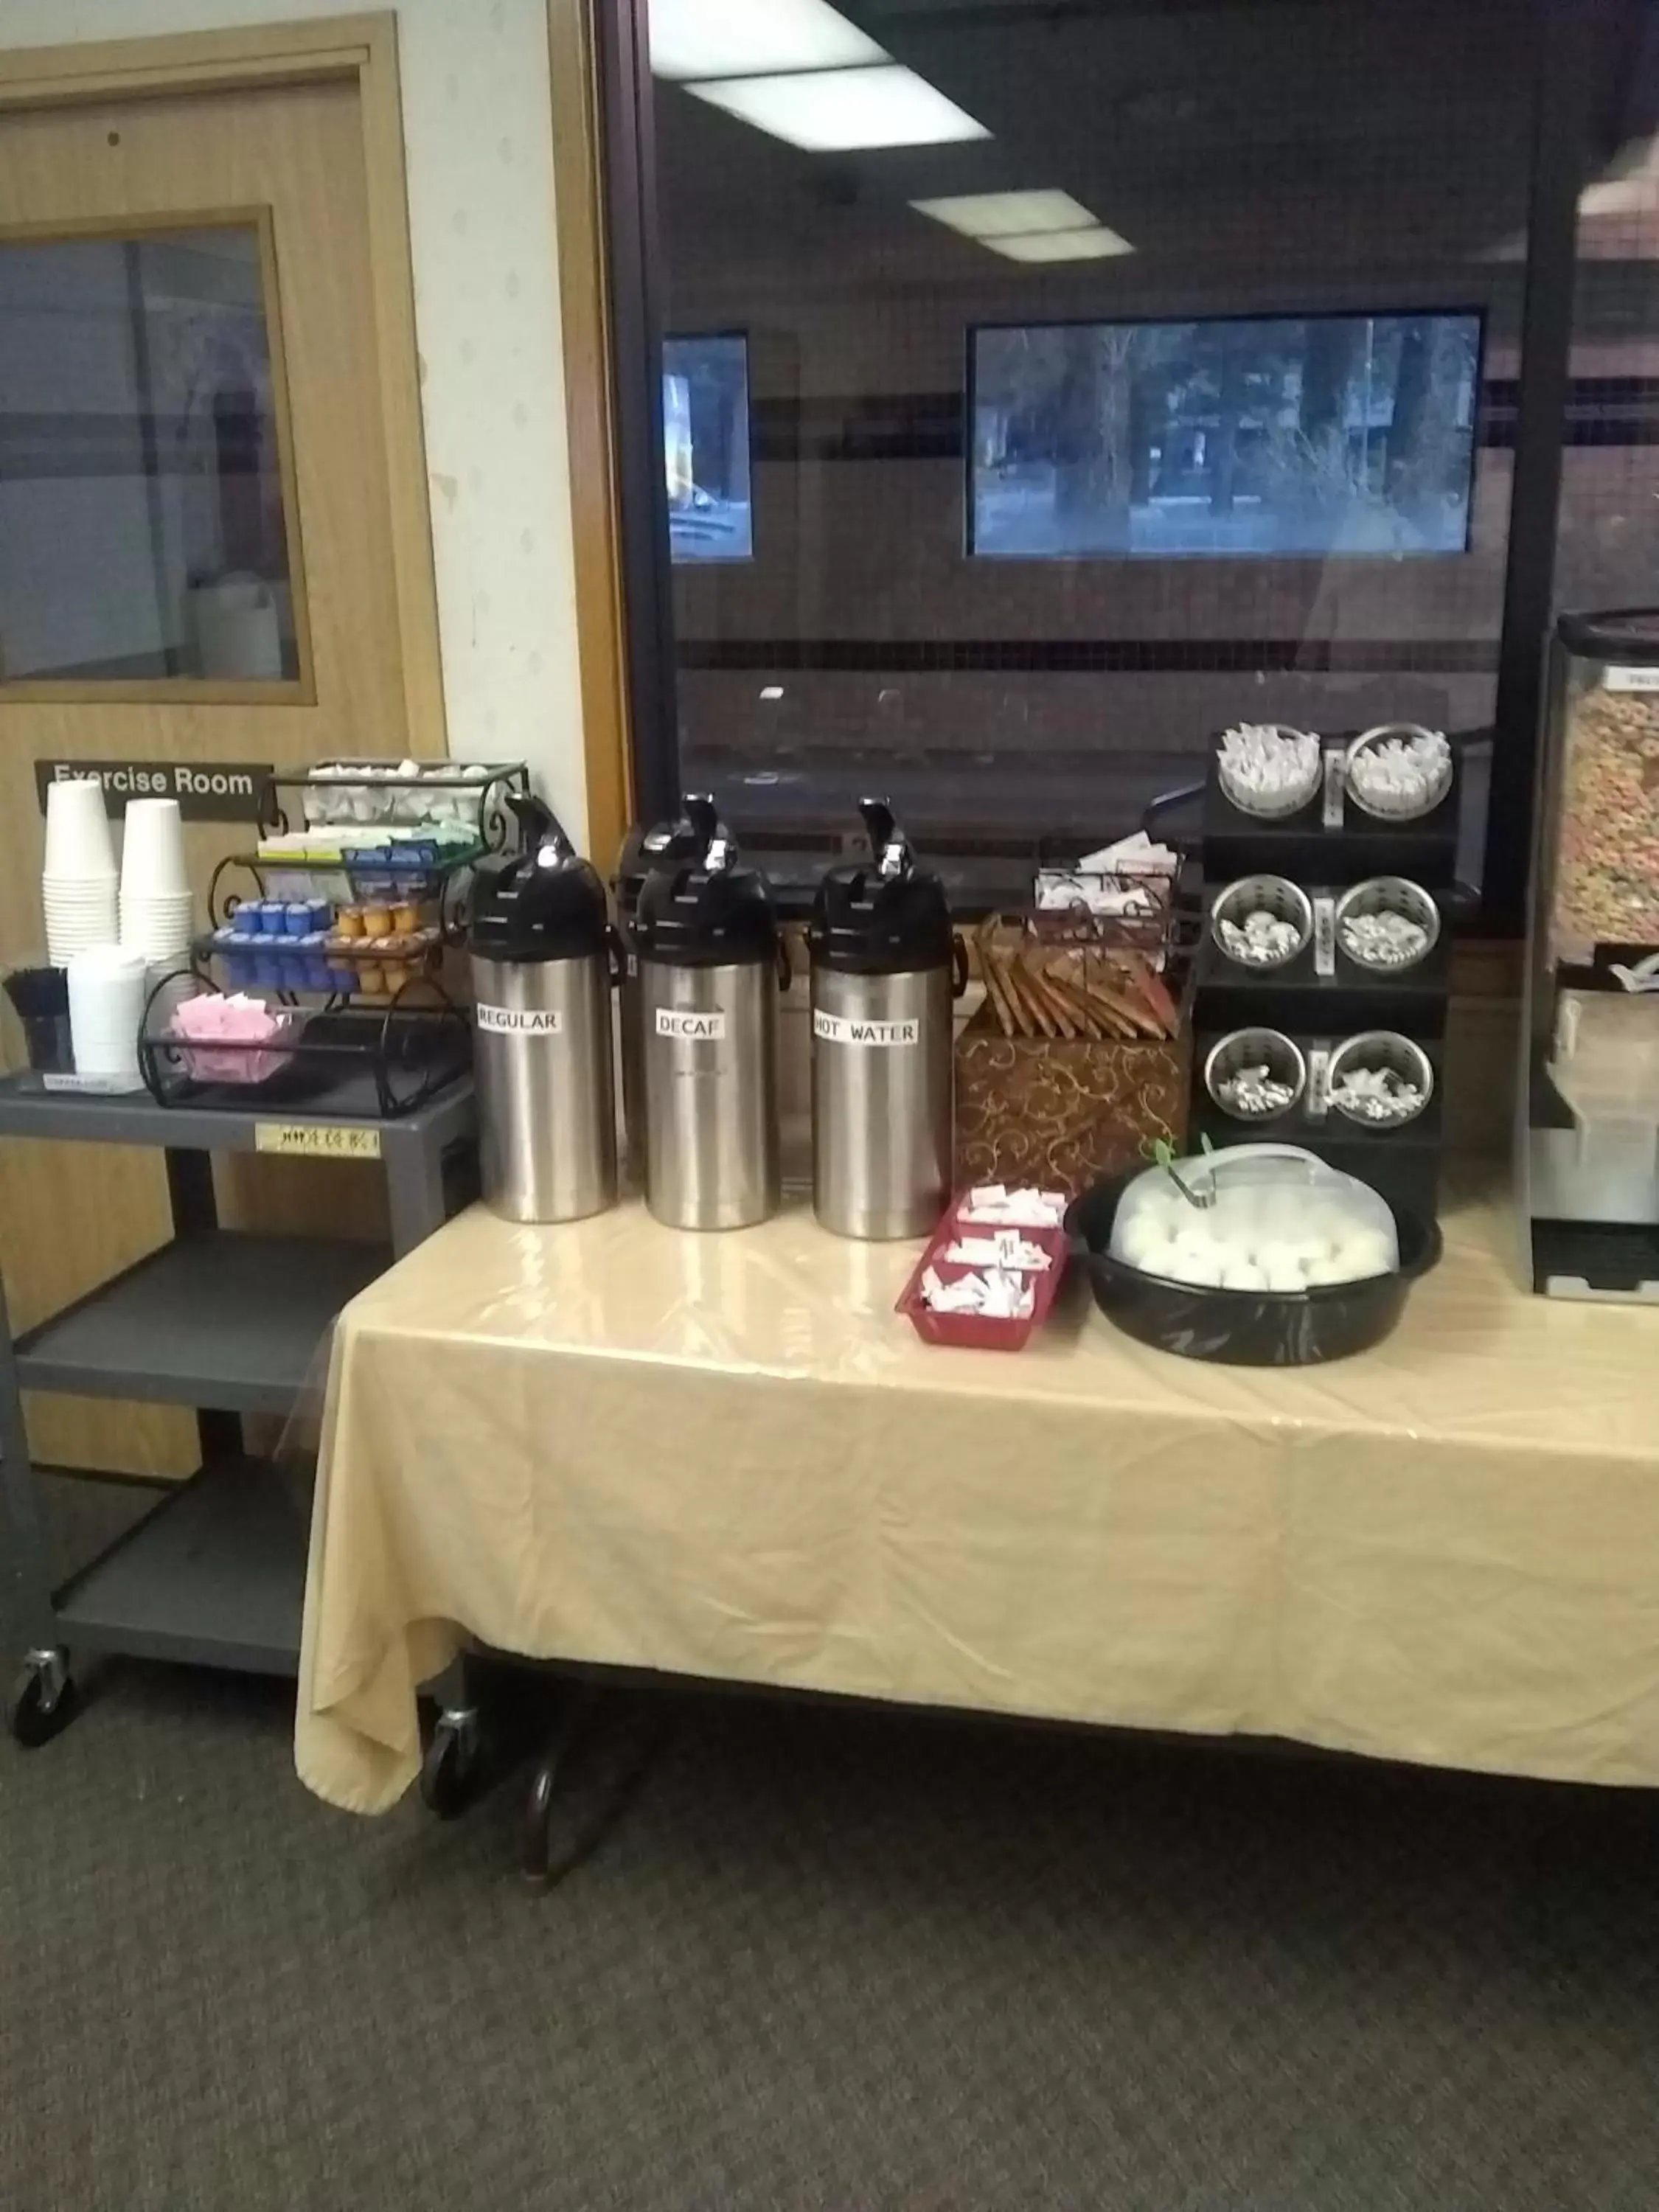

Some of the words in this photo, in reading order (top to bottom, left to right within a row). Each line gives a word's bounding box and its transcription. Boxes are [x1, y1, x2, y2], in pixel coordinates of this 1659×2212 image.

[175, 768, 253, 794] Room
[479, 1008, 557, 1029] REGULAR
[660, 1015, 720, 1036] DECAF
[815, 1014, 841, 1036] HOT
[850, 1023, 914, 1042] WATER
